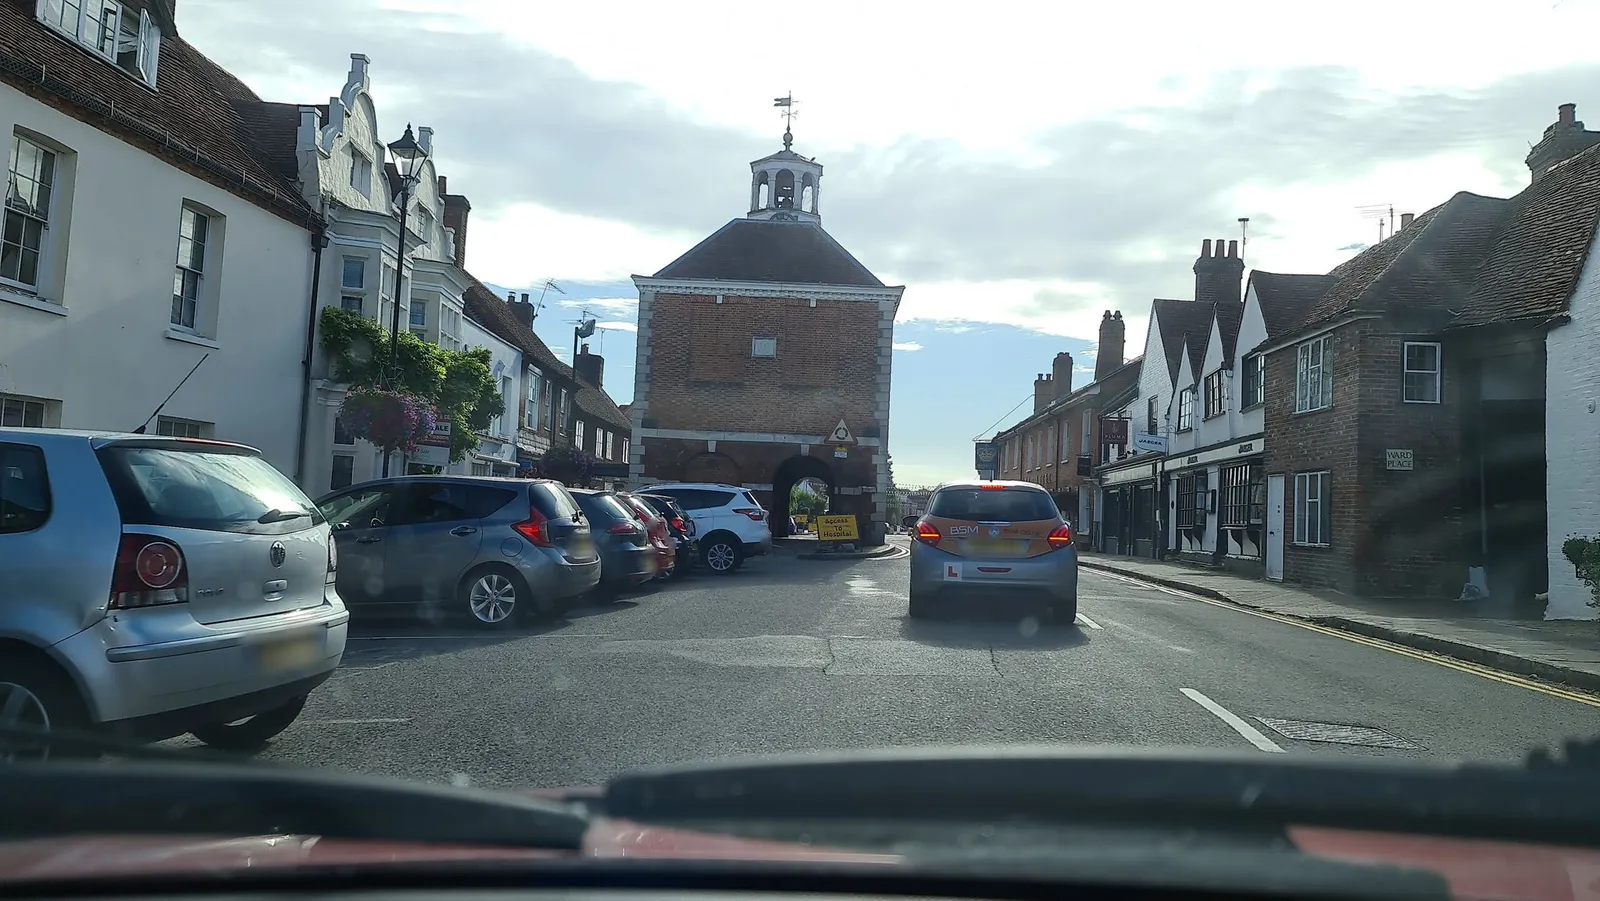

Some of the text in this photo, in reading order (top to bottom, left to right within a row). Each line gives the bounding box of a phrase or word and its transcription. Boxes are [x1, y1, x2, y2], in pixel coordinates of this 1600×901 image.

[1387, 451, 1413, 459] WARD
[1387, 460, 1413, 468] PLACE
[823, 530, 852, 538] Hospital
[950, 525, 979, 535] BSM
[947, 565, 958, 578] L
